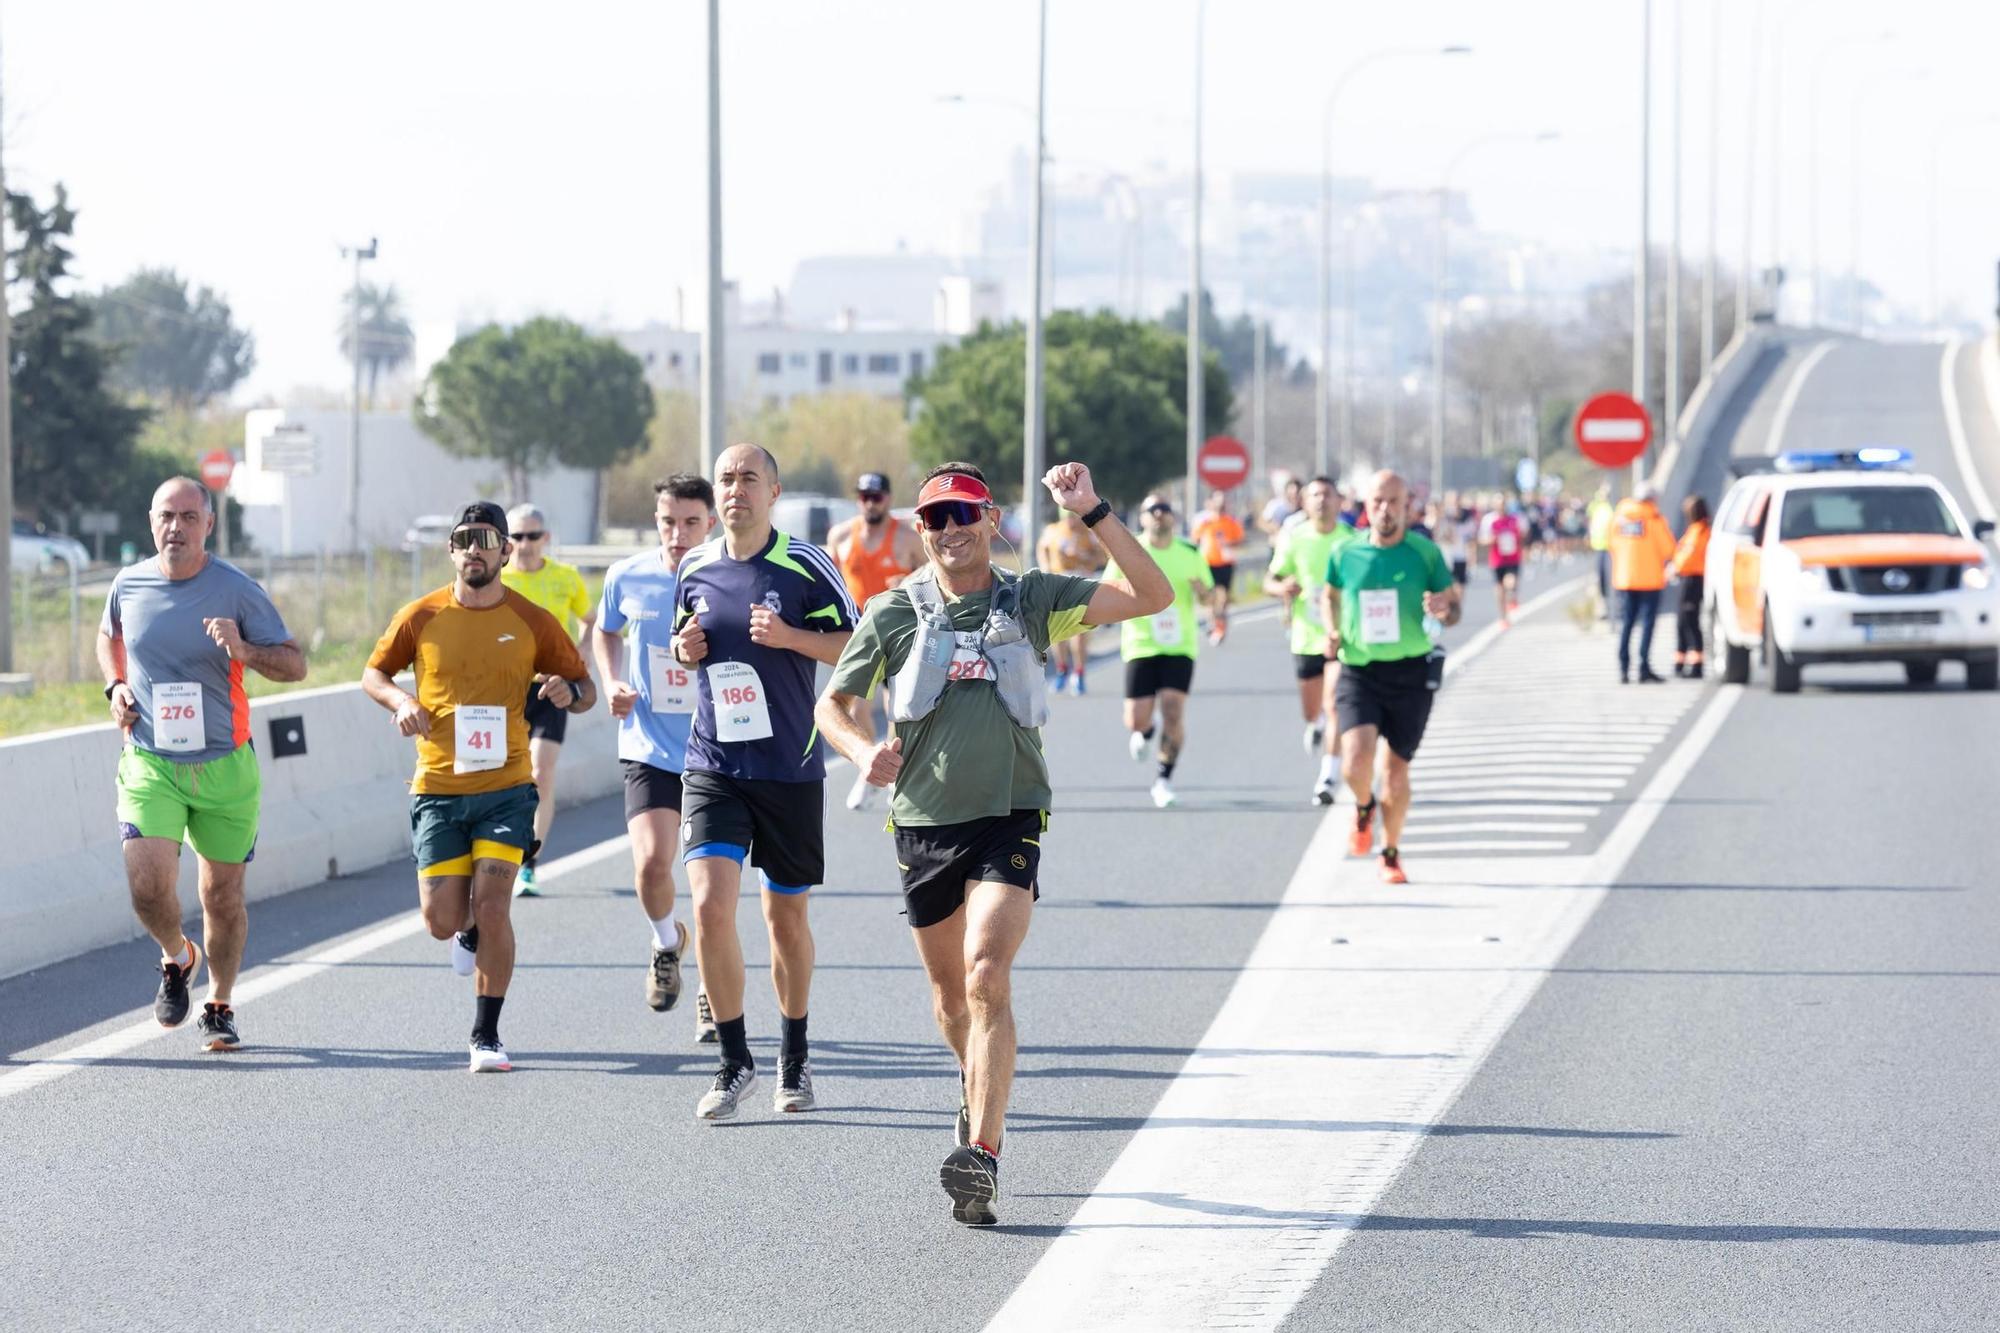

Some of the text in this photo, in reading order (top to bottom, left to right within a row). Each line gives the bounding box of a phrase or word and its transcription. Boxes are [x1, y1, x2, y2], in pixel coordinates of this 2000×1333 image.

[665, 668, 688, 686] 15
[948, 659, 988, 679] 287
[722, 685, 757, 705] 186
[160, 704, 196, 720] 276
[467, 730, 492, 749] 41
